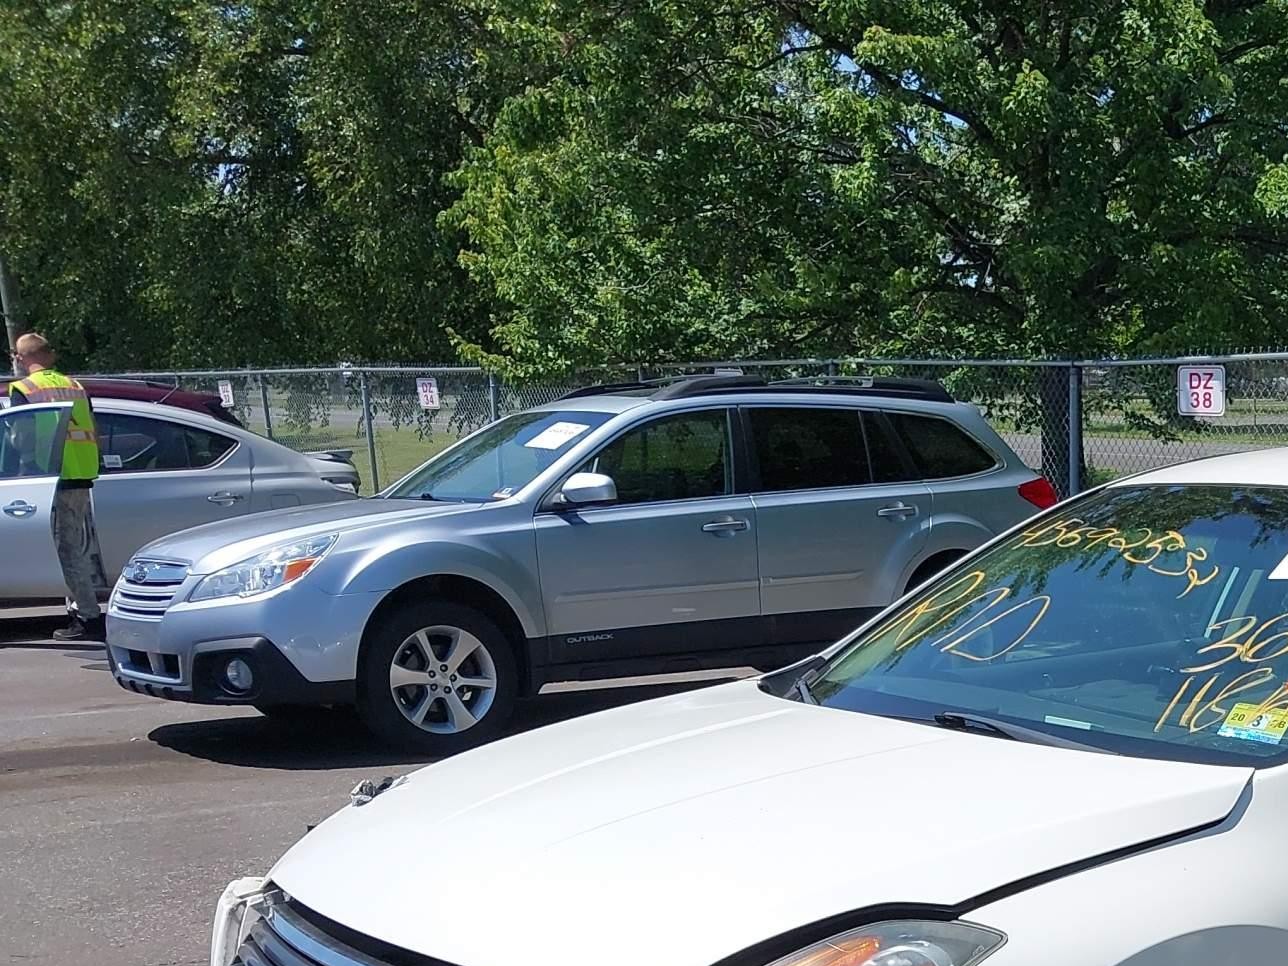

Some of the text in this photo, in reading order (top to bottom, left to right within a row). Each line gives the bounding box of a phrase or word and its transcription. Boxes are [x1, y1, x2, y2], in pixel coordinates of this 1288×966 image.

[1189, 372, 1214, 390] DZ
[1190, 391, 1213, 409] 38
[567, 633, 615, 644] OUTBACK
[1252, 714, 1263, 727] 3
